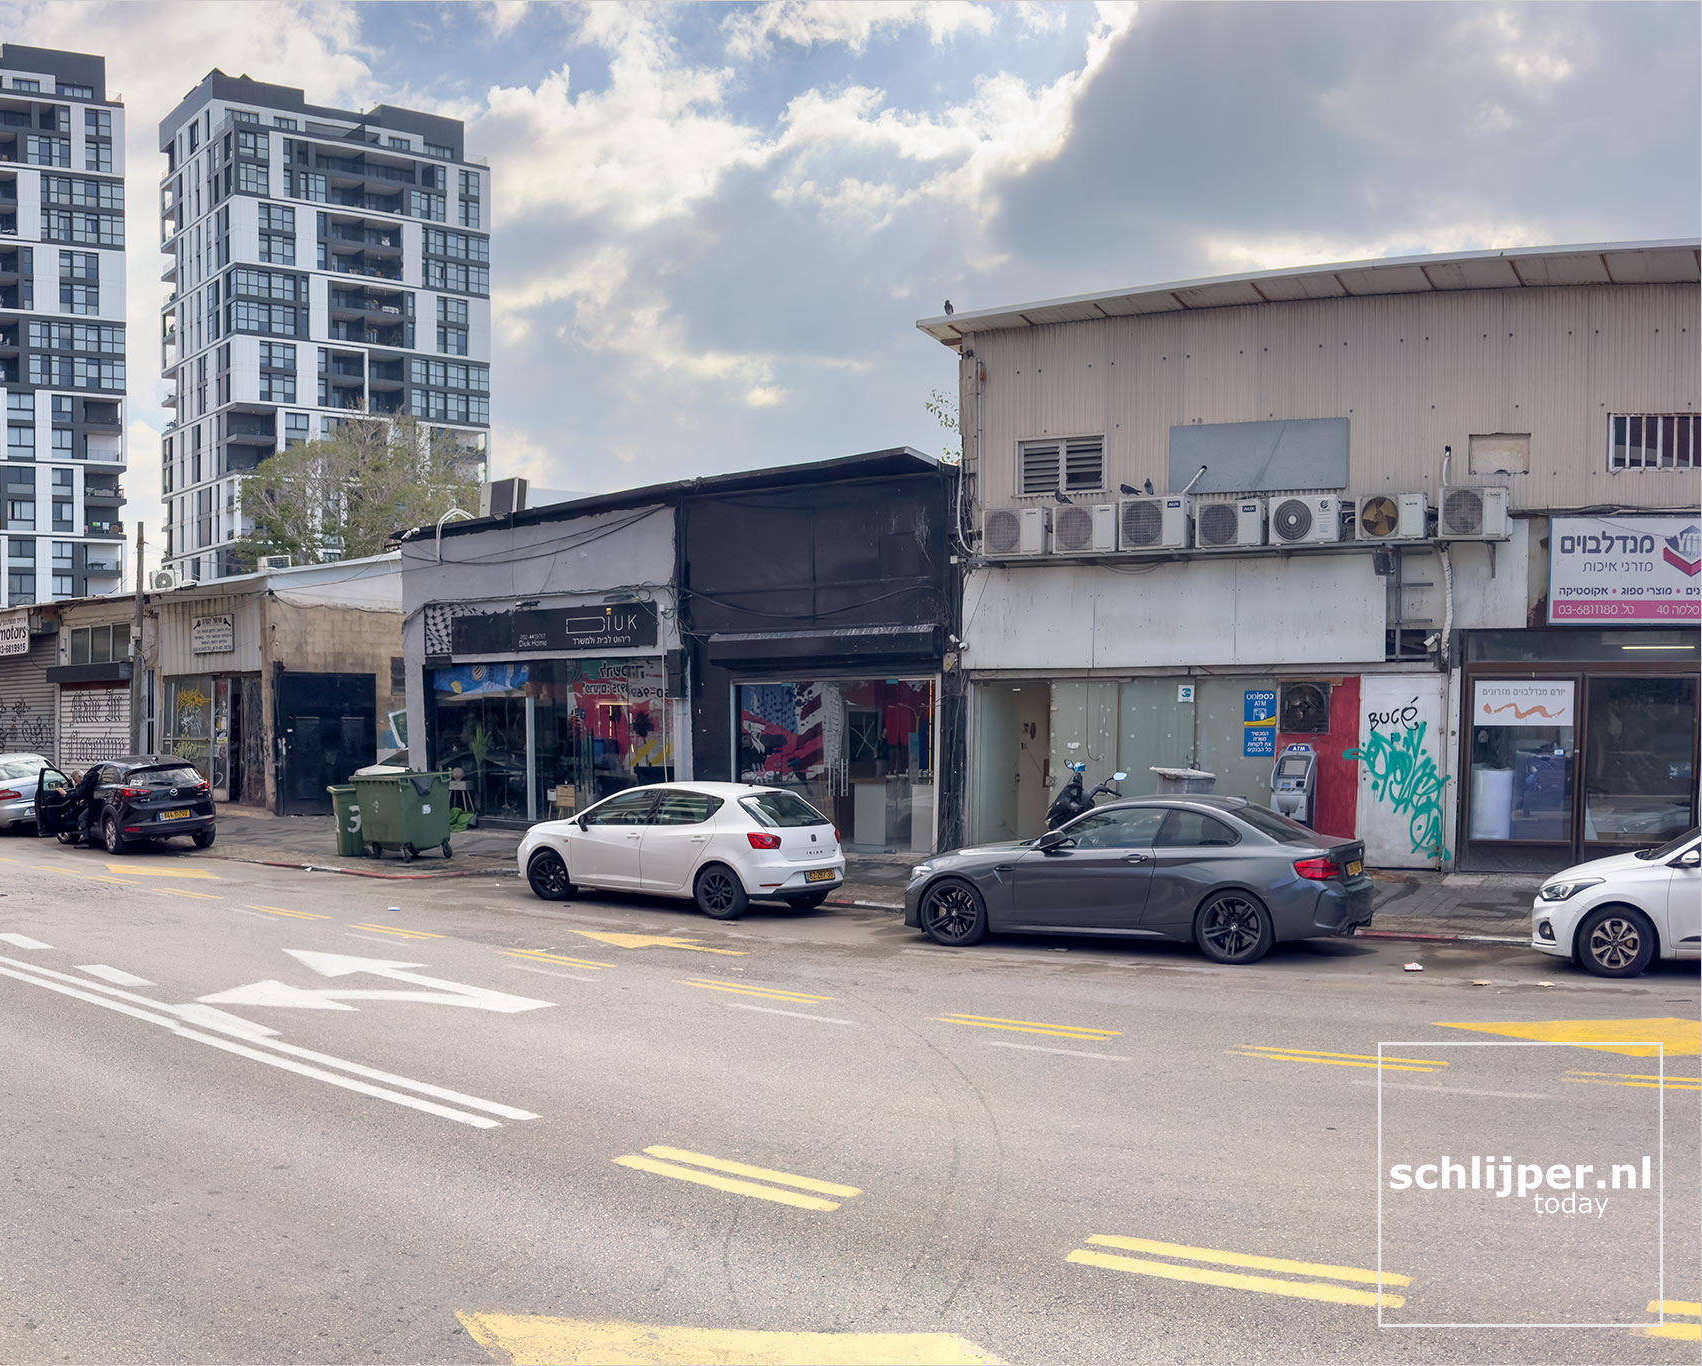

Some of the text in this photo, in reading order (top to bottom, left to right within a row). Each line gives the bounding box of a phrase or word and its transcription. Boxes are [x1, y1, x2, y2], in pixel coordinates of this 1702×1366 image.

[1560, 530, 1655, 554] מנדלבוים
[1582, 561, 1654, 573] מזרני איכות
[1558, 587, 1609, 597] אקוסטיקה
[1620, 587, 1644, 595] ספוג
[1646, 587, 1673, 595] מוצרי
[1558, 604, 1618, 615] 03-6811180
[1656, 605, 1669, 615] 40
[1671, 603, 1700, 615] סלמה
[596, 634, 612, 644] לבית
[613, 635, 631, 643] ריהוט
[1482, 686, 1566, 696] יורם מנדלבוים מזרונים
